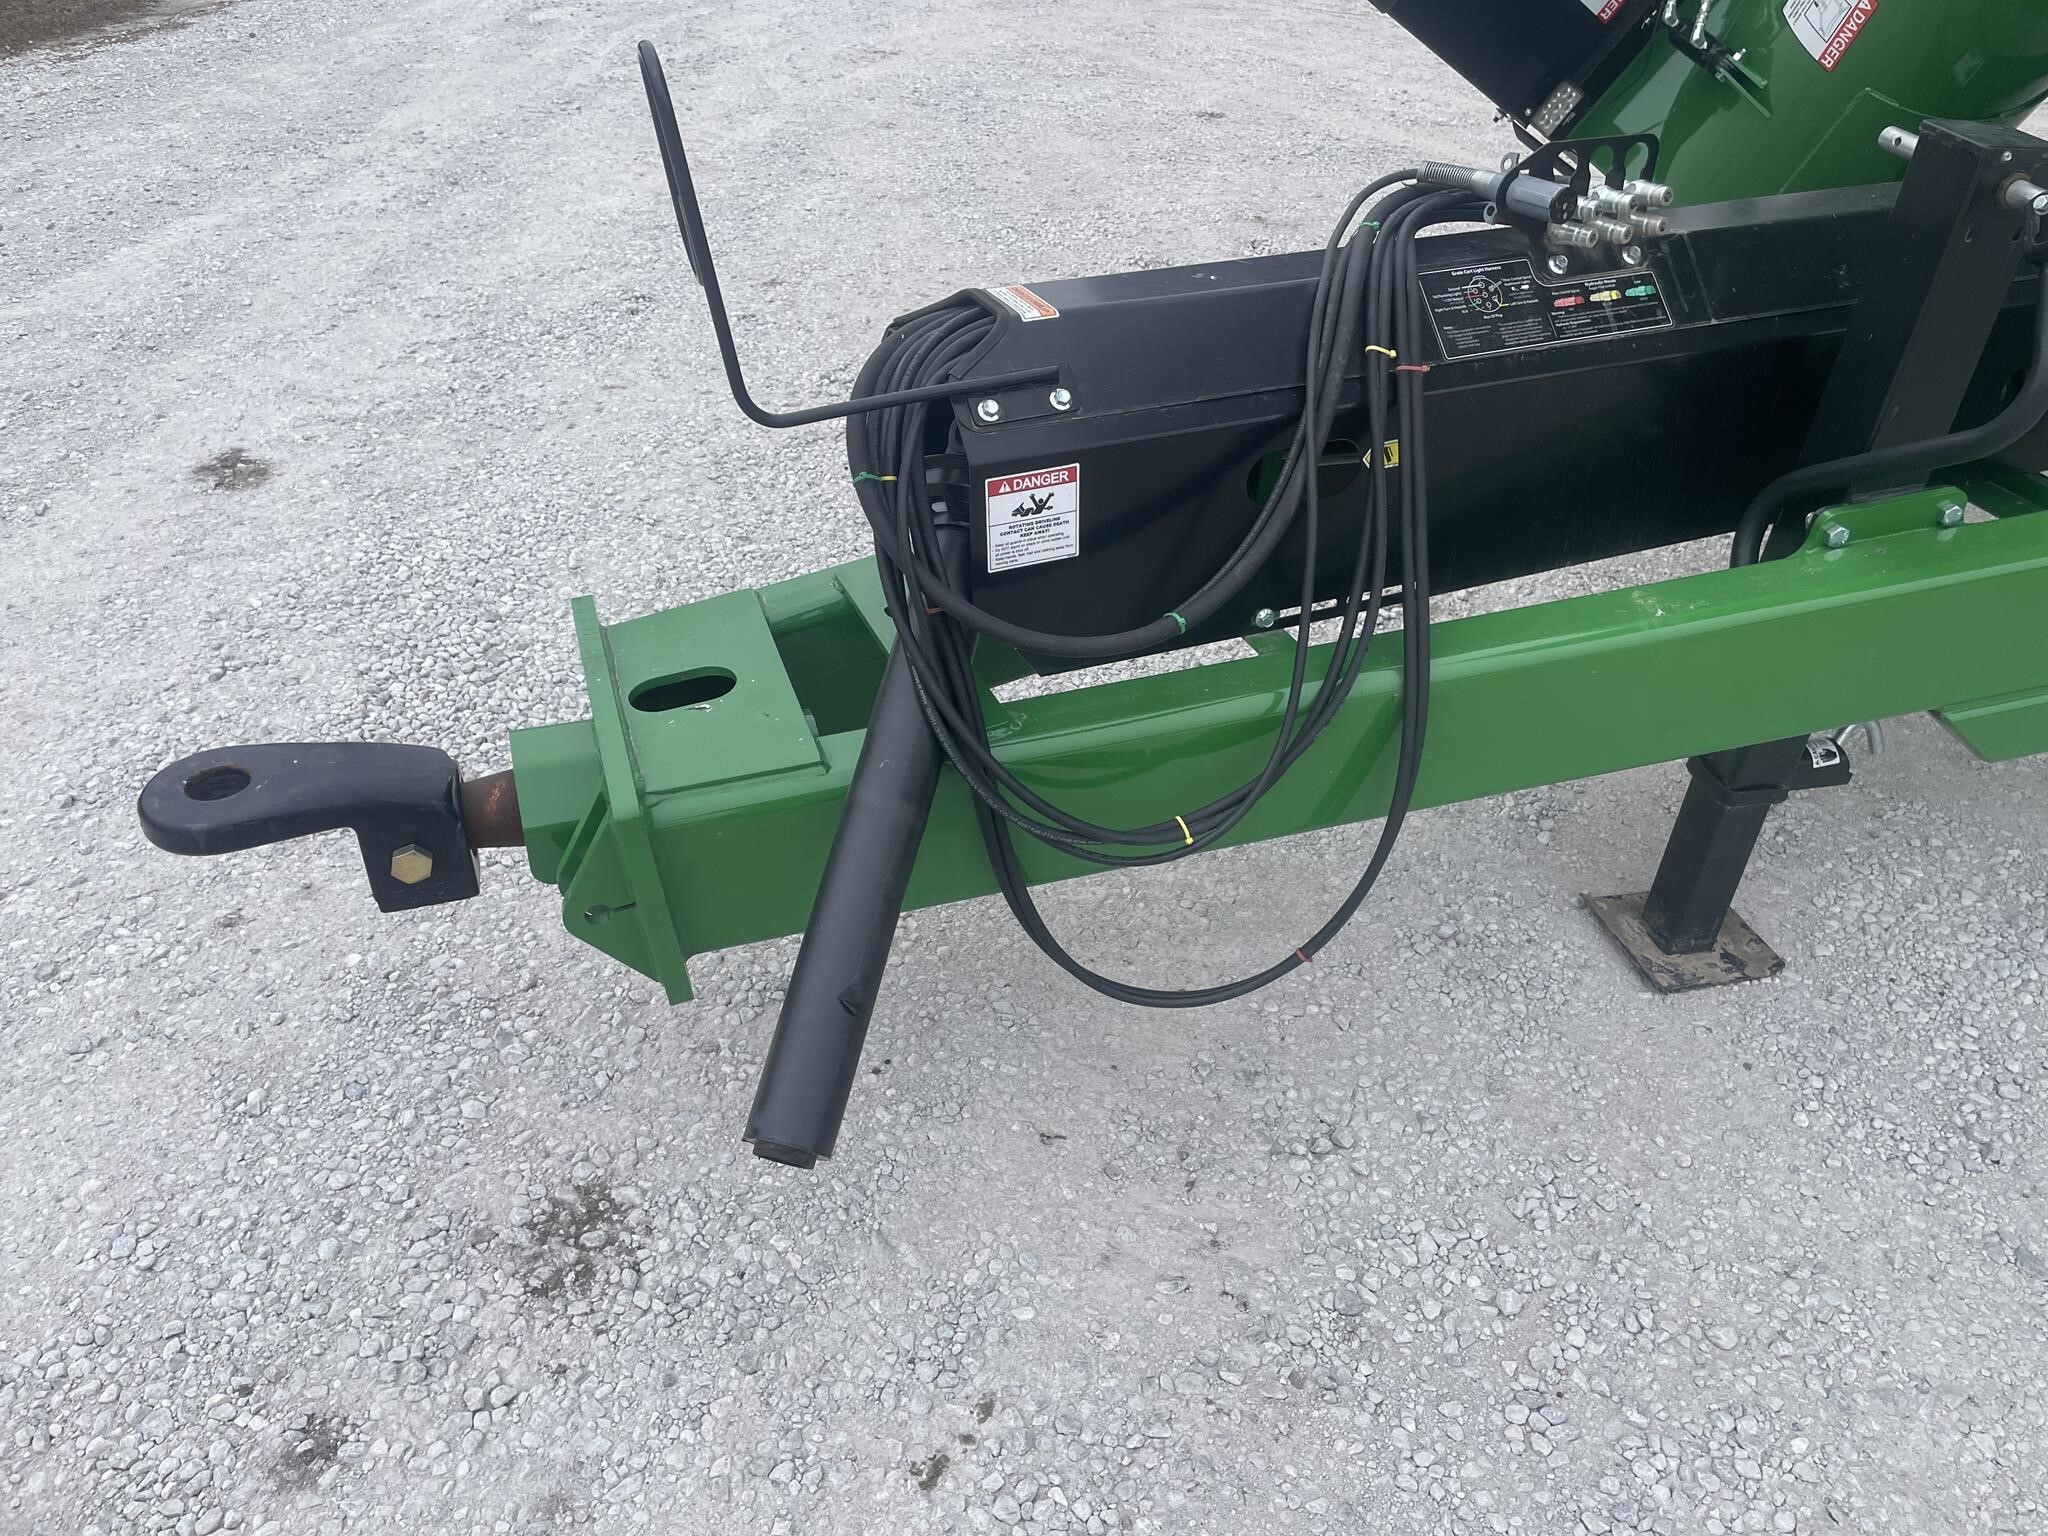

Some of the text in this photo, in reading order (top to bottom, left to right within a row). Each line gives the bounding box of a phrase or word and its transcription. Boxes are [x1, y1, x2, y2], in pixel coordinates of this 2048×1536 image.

[1820, 9, 1865, 69] DANGER
[1013, 471, 1069, 490] DANGER
[1009, 516, 1060, 530] ROTATING DRIVELINE
[1000, 529, 1023, 537] CONTACT
